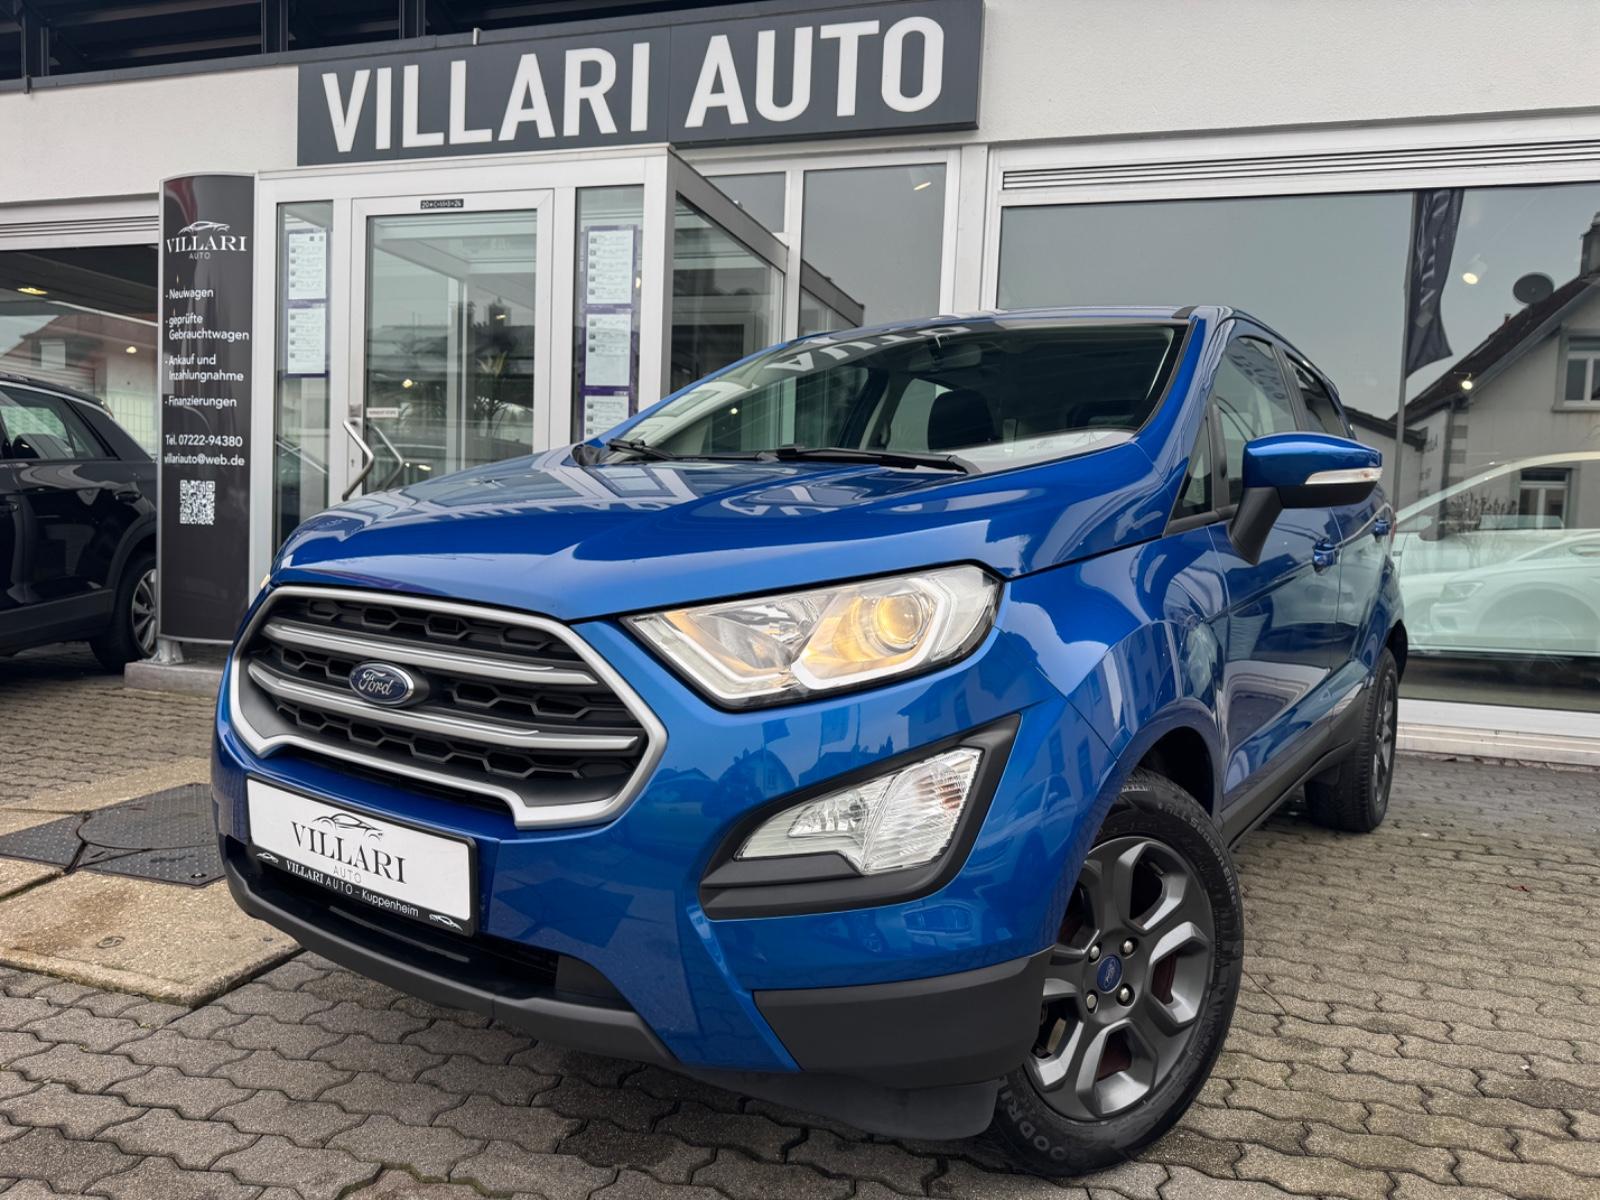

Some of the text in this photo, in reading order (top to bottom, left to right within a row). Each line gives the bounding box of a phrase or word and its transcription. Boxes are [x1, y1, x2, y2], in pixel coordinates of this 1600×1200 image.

[321, 16, 945, 153] VILLARI AUTO
[166, 235, 248, 253] VILLARI
[189, 252, 211, 260] AUTO
[168, 288, 214, 301] Neuwagen
[168, 312, 203, 328] geprüfte
[168, 327, 250, 343] Gebrauchtwagen
[168, 353, 217, 366] Ankauf und
[168, 369, 244, 383] Inzahlungnahme
[168, 395, 237, 409] Finanzierungen
[178, 434, 243, 447] 07222-94380
[358, 669, 394, 696] Ford
[291, 820, 408, 884] VILLARI
[332, 865, 363, 885] AUTO
[286, 860, 325, 884] VILLARI
[325, 877, 354, 896] AUTO
[361, 888, 420, 918] Kuppenheim
